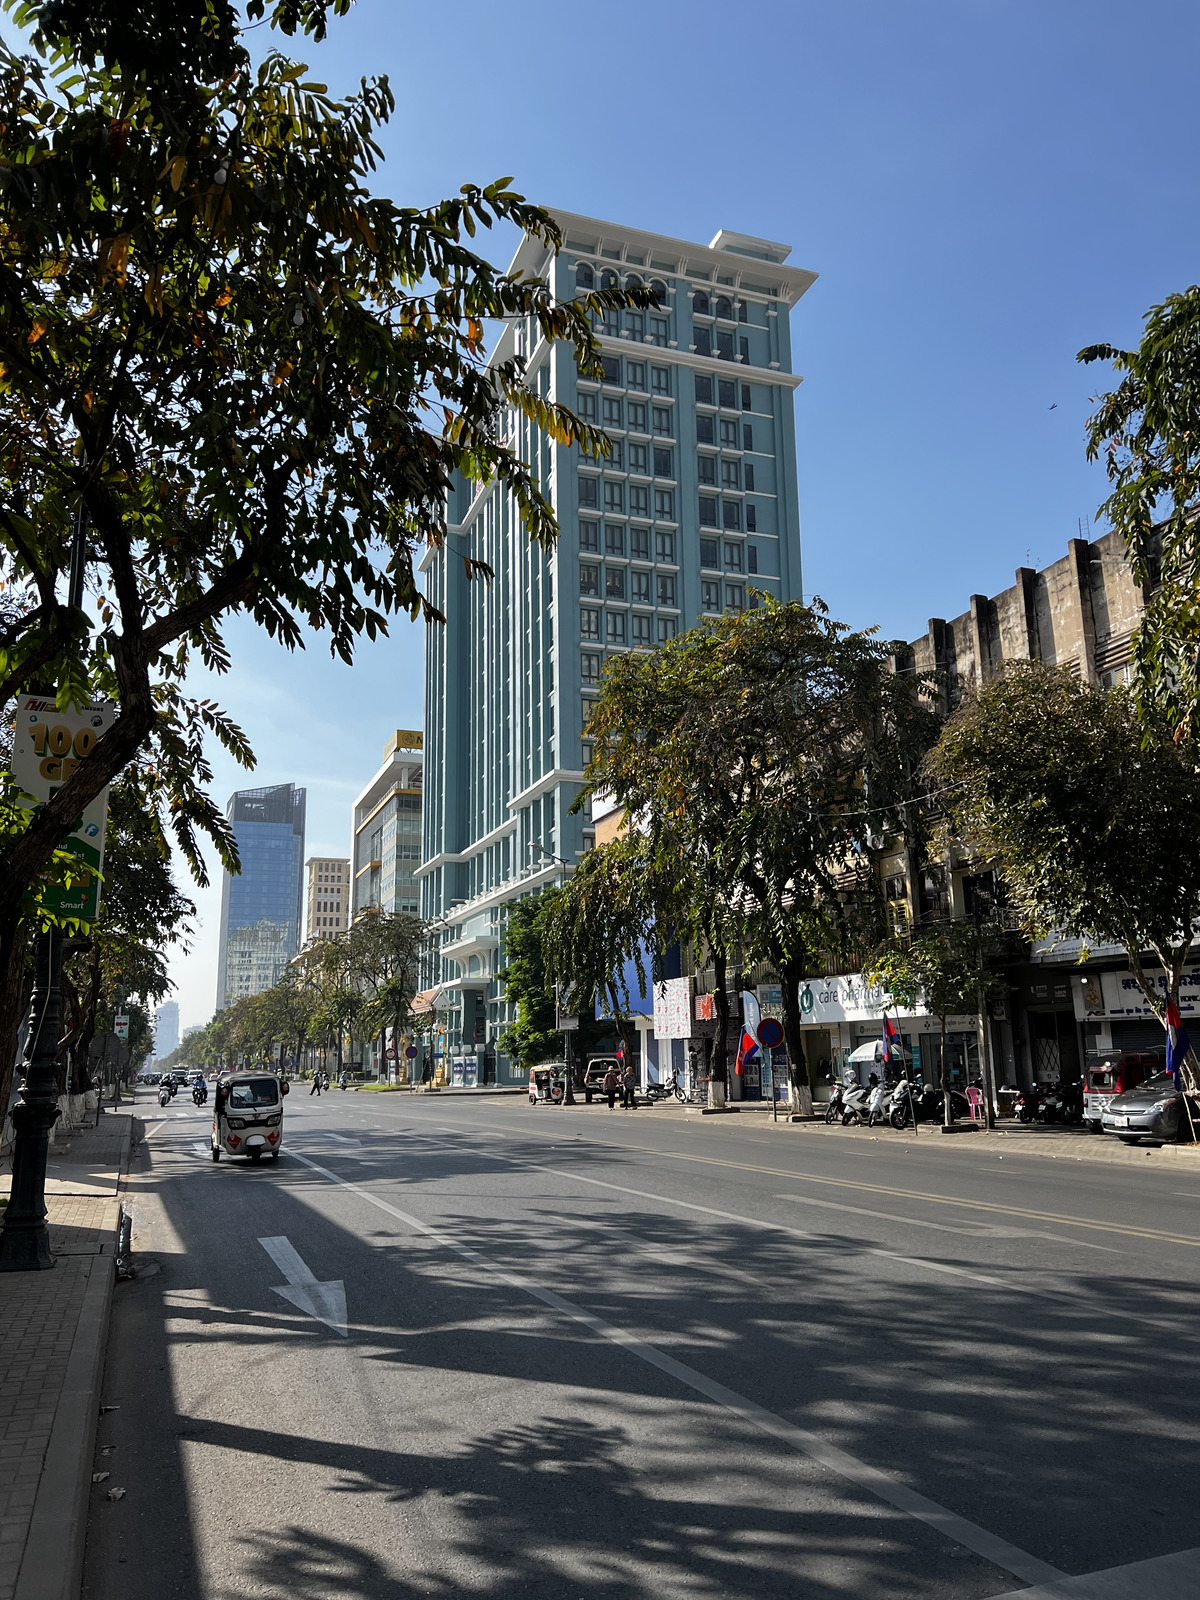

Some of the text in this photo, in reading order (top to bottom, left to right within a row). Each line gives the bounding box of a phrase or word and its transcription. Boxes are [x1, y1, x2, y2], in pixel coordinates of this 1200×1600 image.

[28, 723, 97, 759] 100
[60, 901, 84, 909] Smart
[819, 989, 839, 1004] care
[842, 984, 887, 1005] pharmac
